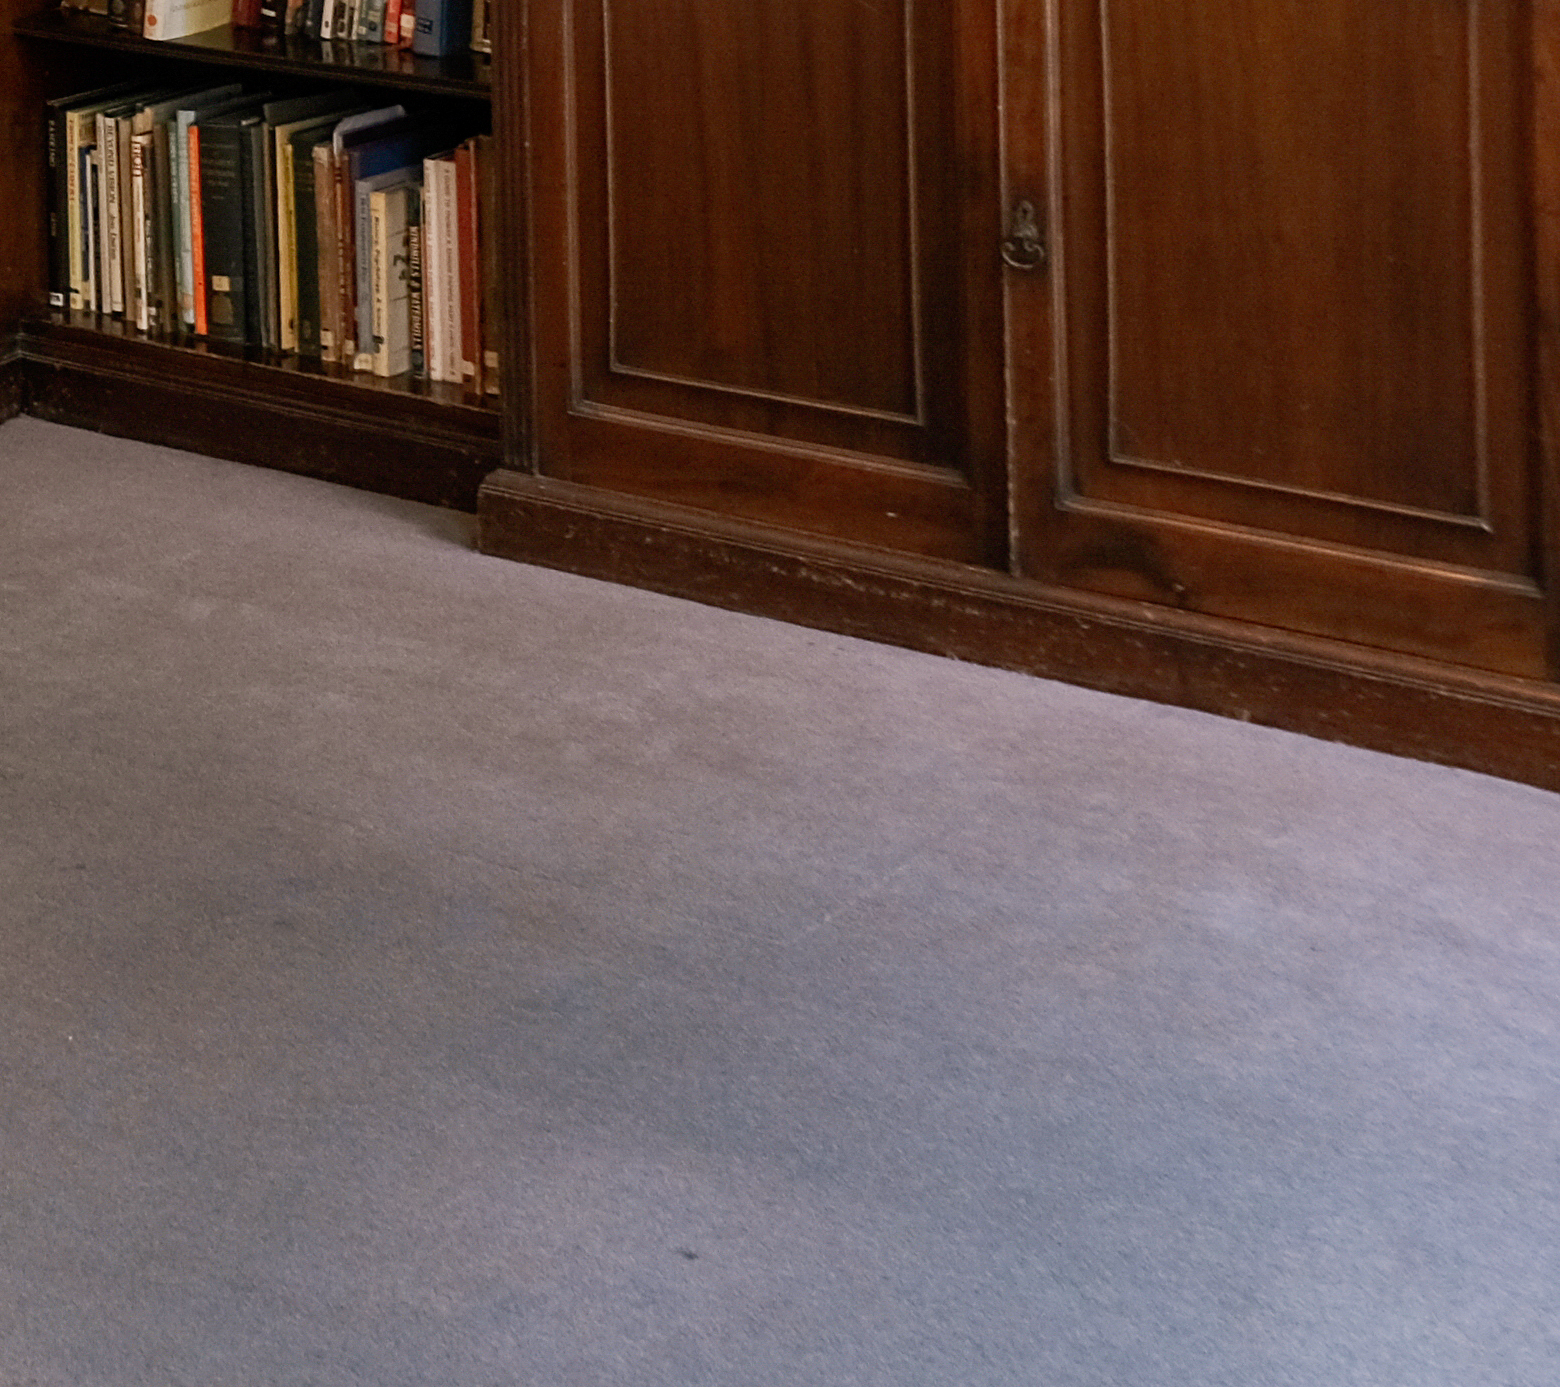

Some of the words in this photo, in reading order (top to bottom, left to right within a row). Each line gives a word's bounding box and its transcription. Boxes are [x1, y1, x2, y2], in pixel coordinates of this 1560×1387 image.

[107, 125, 115, 166] BEYOND
[108, 170, 117, 205] VISION
[409, 226, 419, 277] WINDMILLS
[411, 292, 421, 349] WATERMILLS
